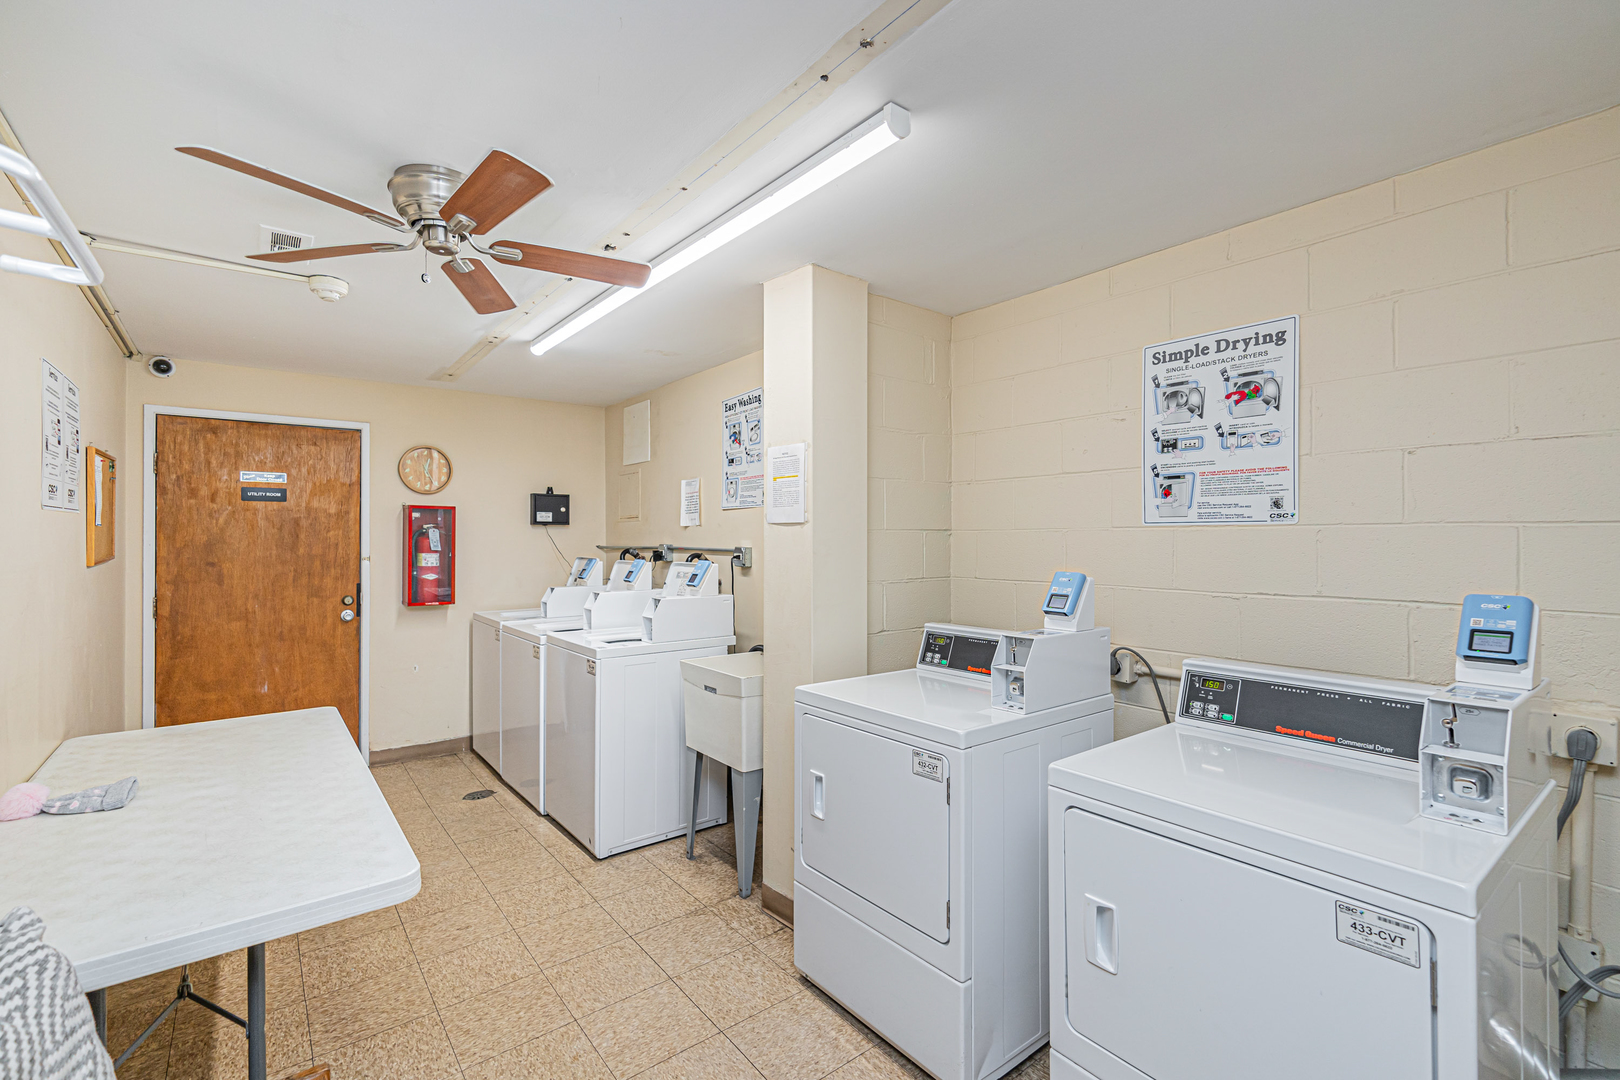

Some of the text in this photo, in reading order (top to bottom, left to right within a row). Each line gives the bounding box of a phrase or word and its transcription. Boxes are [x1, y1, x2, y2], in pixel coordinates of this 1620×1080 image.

[1152, 343, 1210, 365] Simple
[1215, 330, 1287, 354] Drying
[1165, 356, 1236, 374] SINGLE-LOAD/STACK
[1237, 350, 1269, 361] DRYERS
[725, 403, 737, 412] Easy
[738, 395, 762, 408] Washing
[1206, 681, 1220, 689] 150
[1271, 685, 1309, 694] PERMANENT
[1275, 725, 1394, 754] Speed Queen Commercial Dryer
[918, 761, 938, 771] 432-CVT
[1338, 904, 1358, 914] CSC
[1350, 922, 1406, 946] 433-CVT
